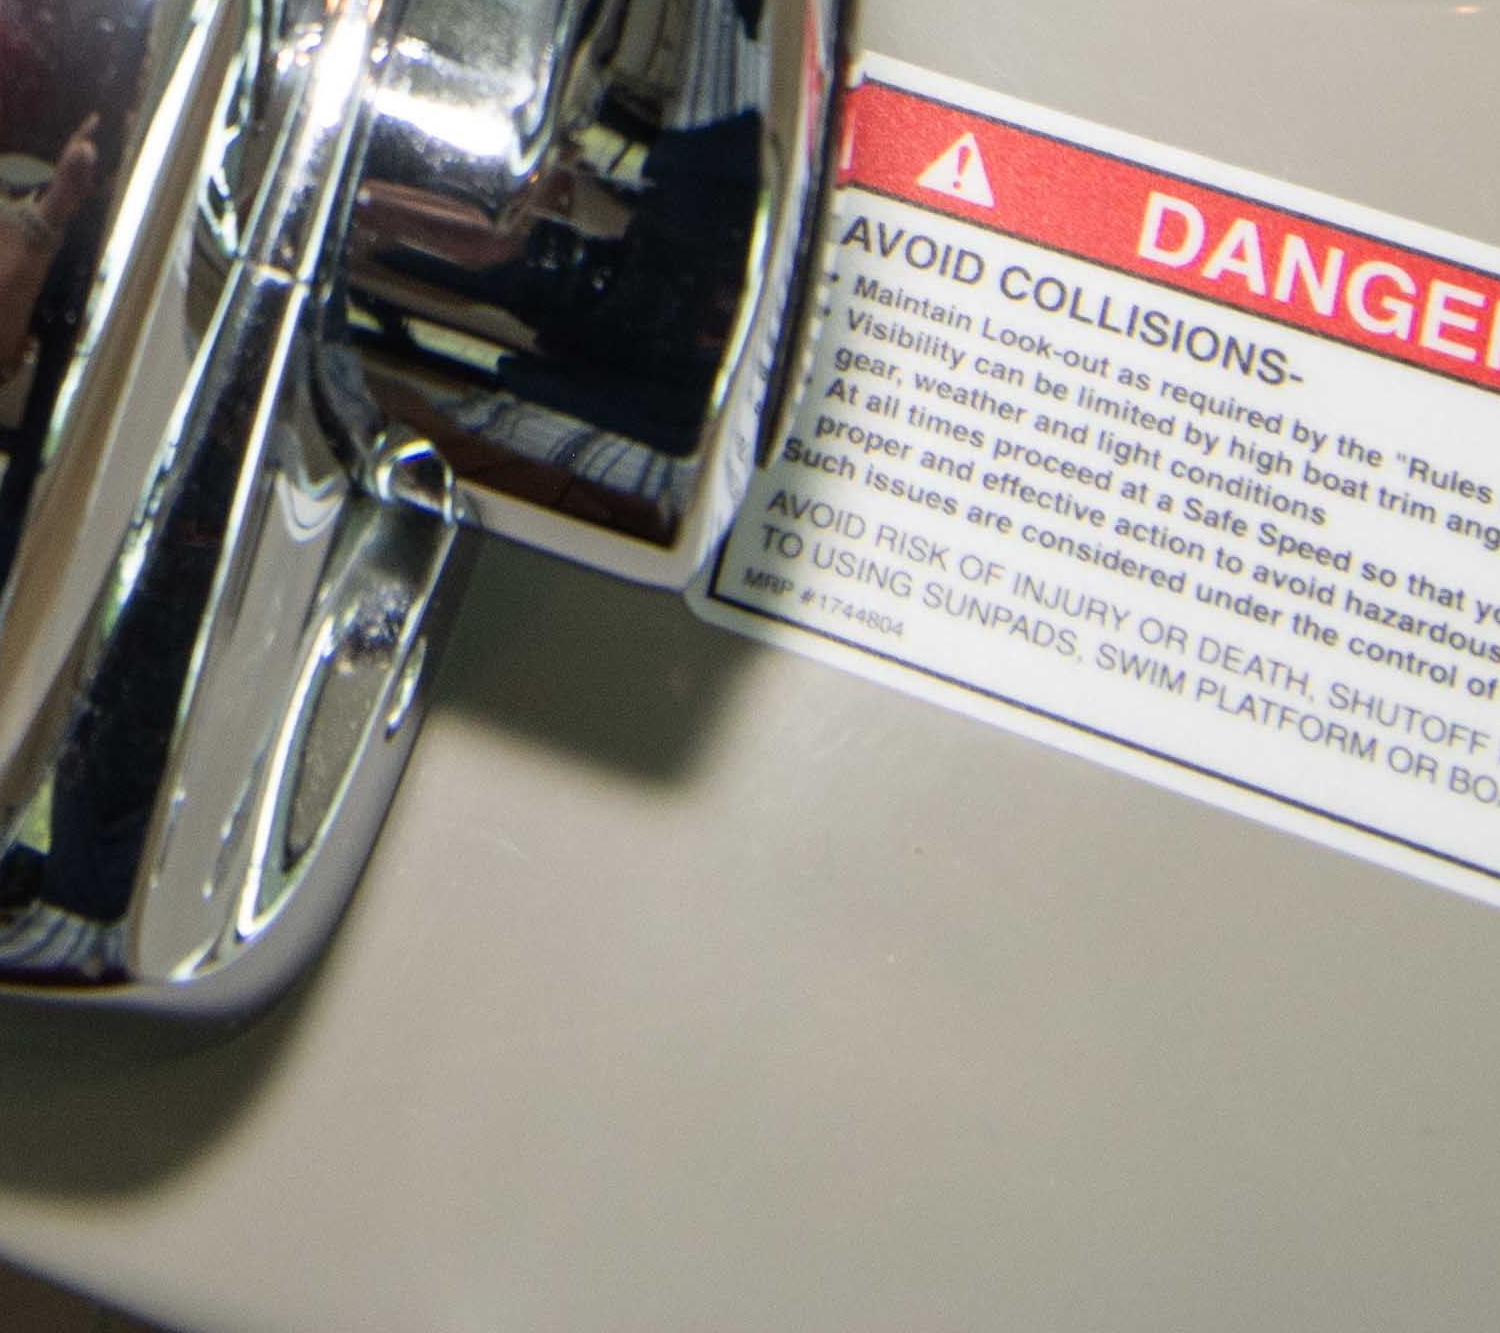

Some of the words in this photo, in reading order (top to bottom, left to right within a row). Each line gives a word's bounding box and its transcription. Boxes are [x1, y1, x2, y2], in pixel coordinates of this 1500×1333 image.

[840, 216, 985, 285] AVOID
[1000, 266, 1303, 386] COLLISIONS-
[852, 275, 973, 333] Maintain
[981, 317, 1110, 379] Look-out
[1117, 368, 1152, 392] as
[1160, 382, 1284, 436] required
[1291, 418, 1329, 454] by
[1338, 435, 1383, 468] the
[814, 415, 913, 460] proper
[921, 451, 976, 483] and
[982, 472, 1107, 528] effective
[1114, 518, 1206, 563] action
[1216, 546, 1245, 575] to
[1252, 565, 1337, 607] avoid
[848, 308, 967, 371] Visibility
[974, 357, 1025, 387] can
[1034, 372, 1069, 402] be
[1078, 386, 1176, 437] limited
[1184, 422, 1220, 456] by
[1229, 436, 1293, 476] high
[1303, 460, 1369, 502] boat
[1379, 487, 1437, 525] trim
[762, 524, 804, 560] TO
[812, 542, 913, 598] USING
[922, 582, 1083, 662] SUNPADS,
[1095, 642, 1188, 695] SWIM
[1196, 678, 1379, 763] PLATFORM
[1387, 746, 1439, 784] OR
[765, 490, 867, 540] AVOID
[875, 524, 950, 572] RISK
[959, 554, 1005, 586] OF
[1013, 572, 1132, 631] INJURY
[1139, 617, 1189, 654] OR
[1197, 636, 1314, 702] DEATH,
[1328, 683, 1491, 755] SHUTOFF
